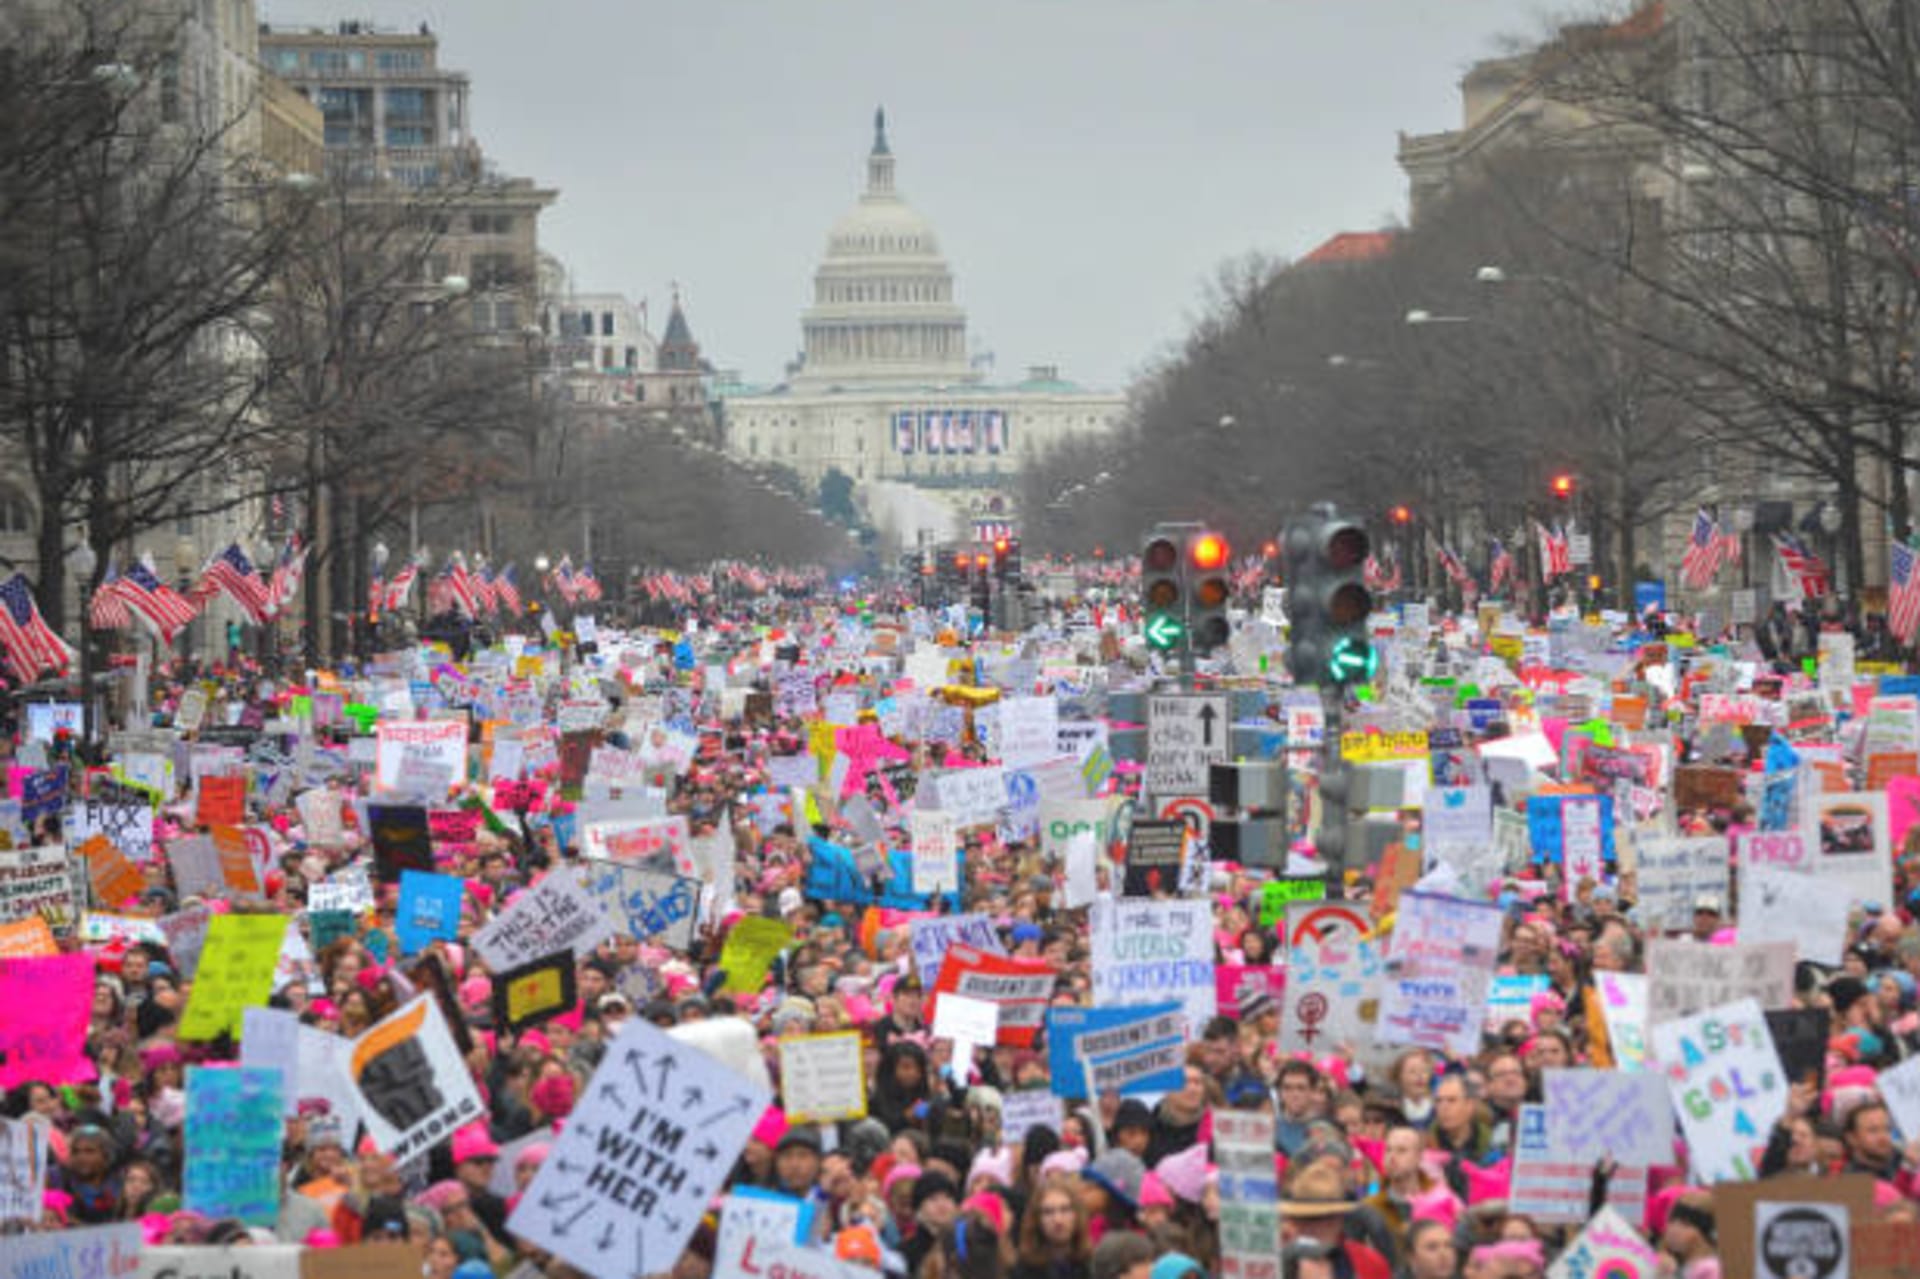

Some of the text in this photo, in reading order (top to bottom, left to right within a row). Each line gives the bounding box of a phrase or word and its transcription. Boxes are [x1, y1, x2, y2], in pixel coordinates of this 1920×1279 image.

[1081, 1022, 1150, 1055] DISSENT
[1091, 1046, 1175, 1083] PATRIOTIC
[394, 1096, 476, 1157] WRONG
[629, 1106, 686, 1153] I'M
[597, 1124, 688, 1195] WITH
[586, 1162, 659, 1218] HER
